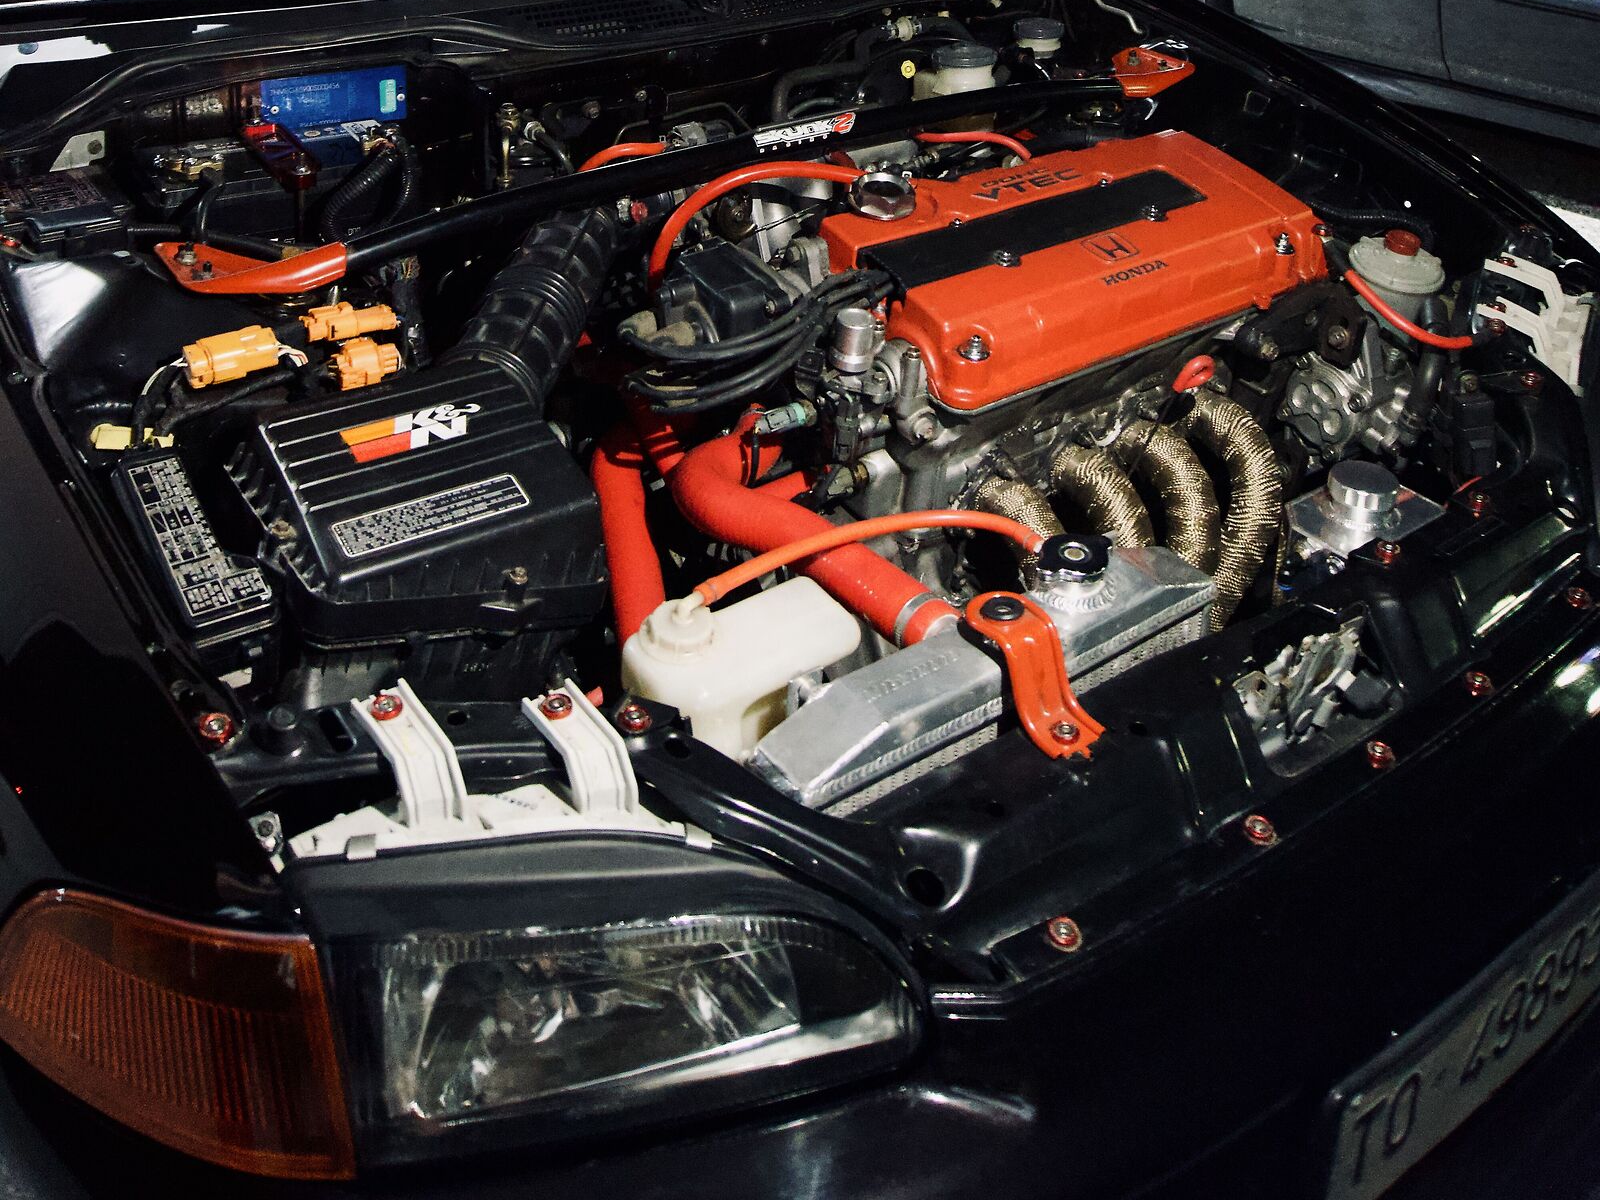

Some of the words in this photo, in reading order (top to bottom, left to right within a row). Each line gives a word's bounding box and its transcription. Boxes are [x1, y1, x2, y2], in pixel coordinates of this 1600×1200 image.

[971, 168, 1082, 201] VTEC
[981, 168, 1050, 188] DOHC
[1103, 260, 1169, 286] HONDA
[394, 403, 481, 449] K&N
